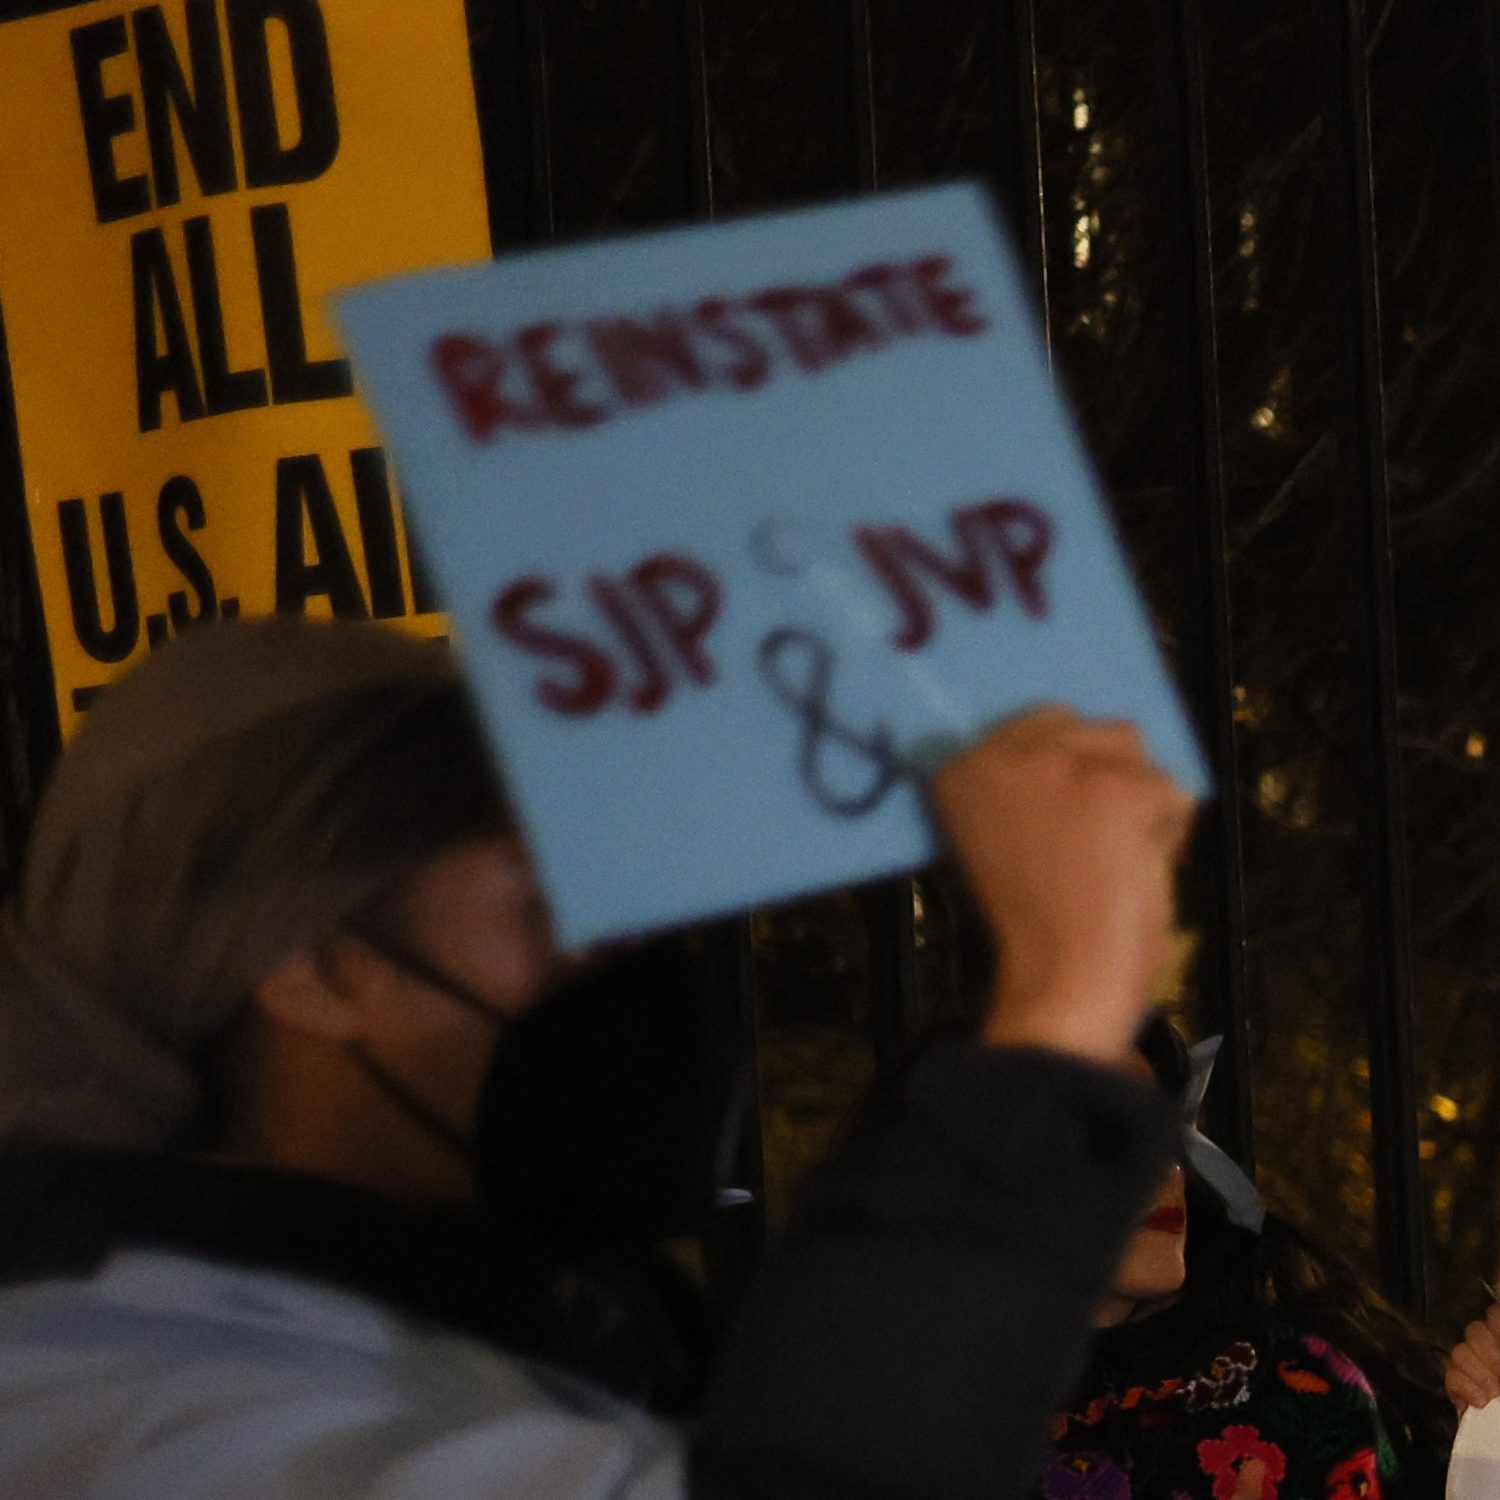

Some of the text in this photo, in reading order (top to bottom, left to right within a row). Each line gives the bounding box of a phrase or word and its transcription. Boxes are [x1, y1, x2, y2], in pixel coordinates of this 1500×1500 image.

[69, 0, 340, 224] END
[130, 203, 353, 432] ALL
[428, 254, 987, 444] REINSTATE
[57, 447, 446, 664] U.S. AI
[491, 497, 1055, 820] SJP & JVP
